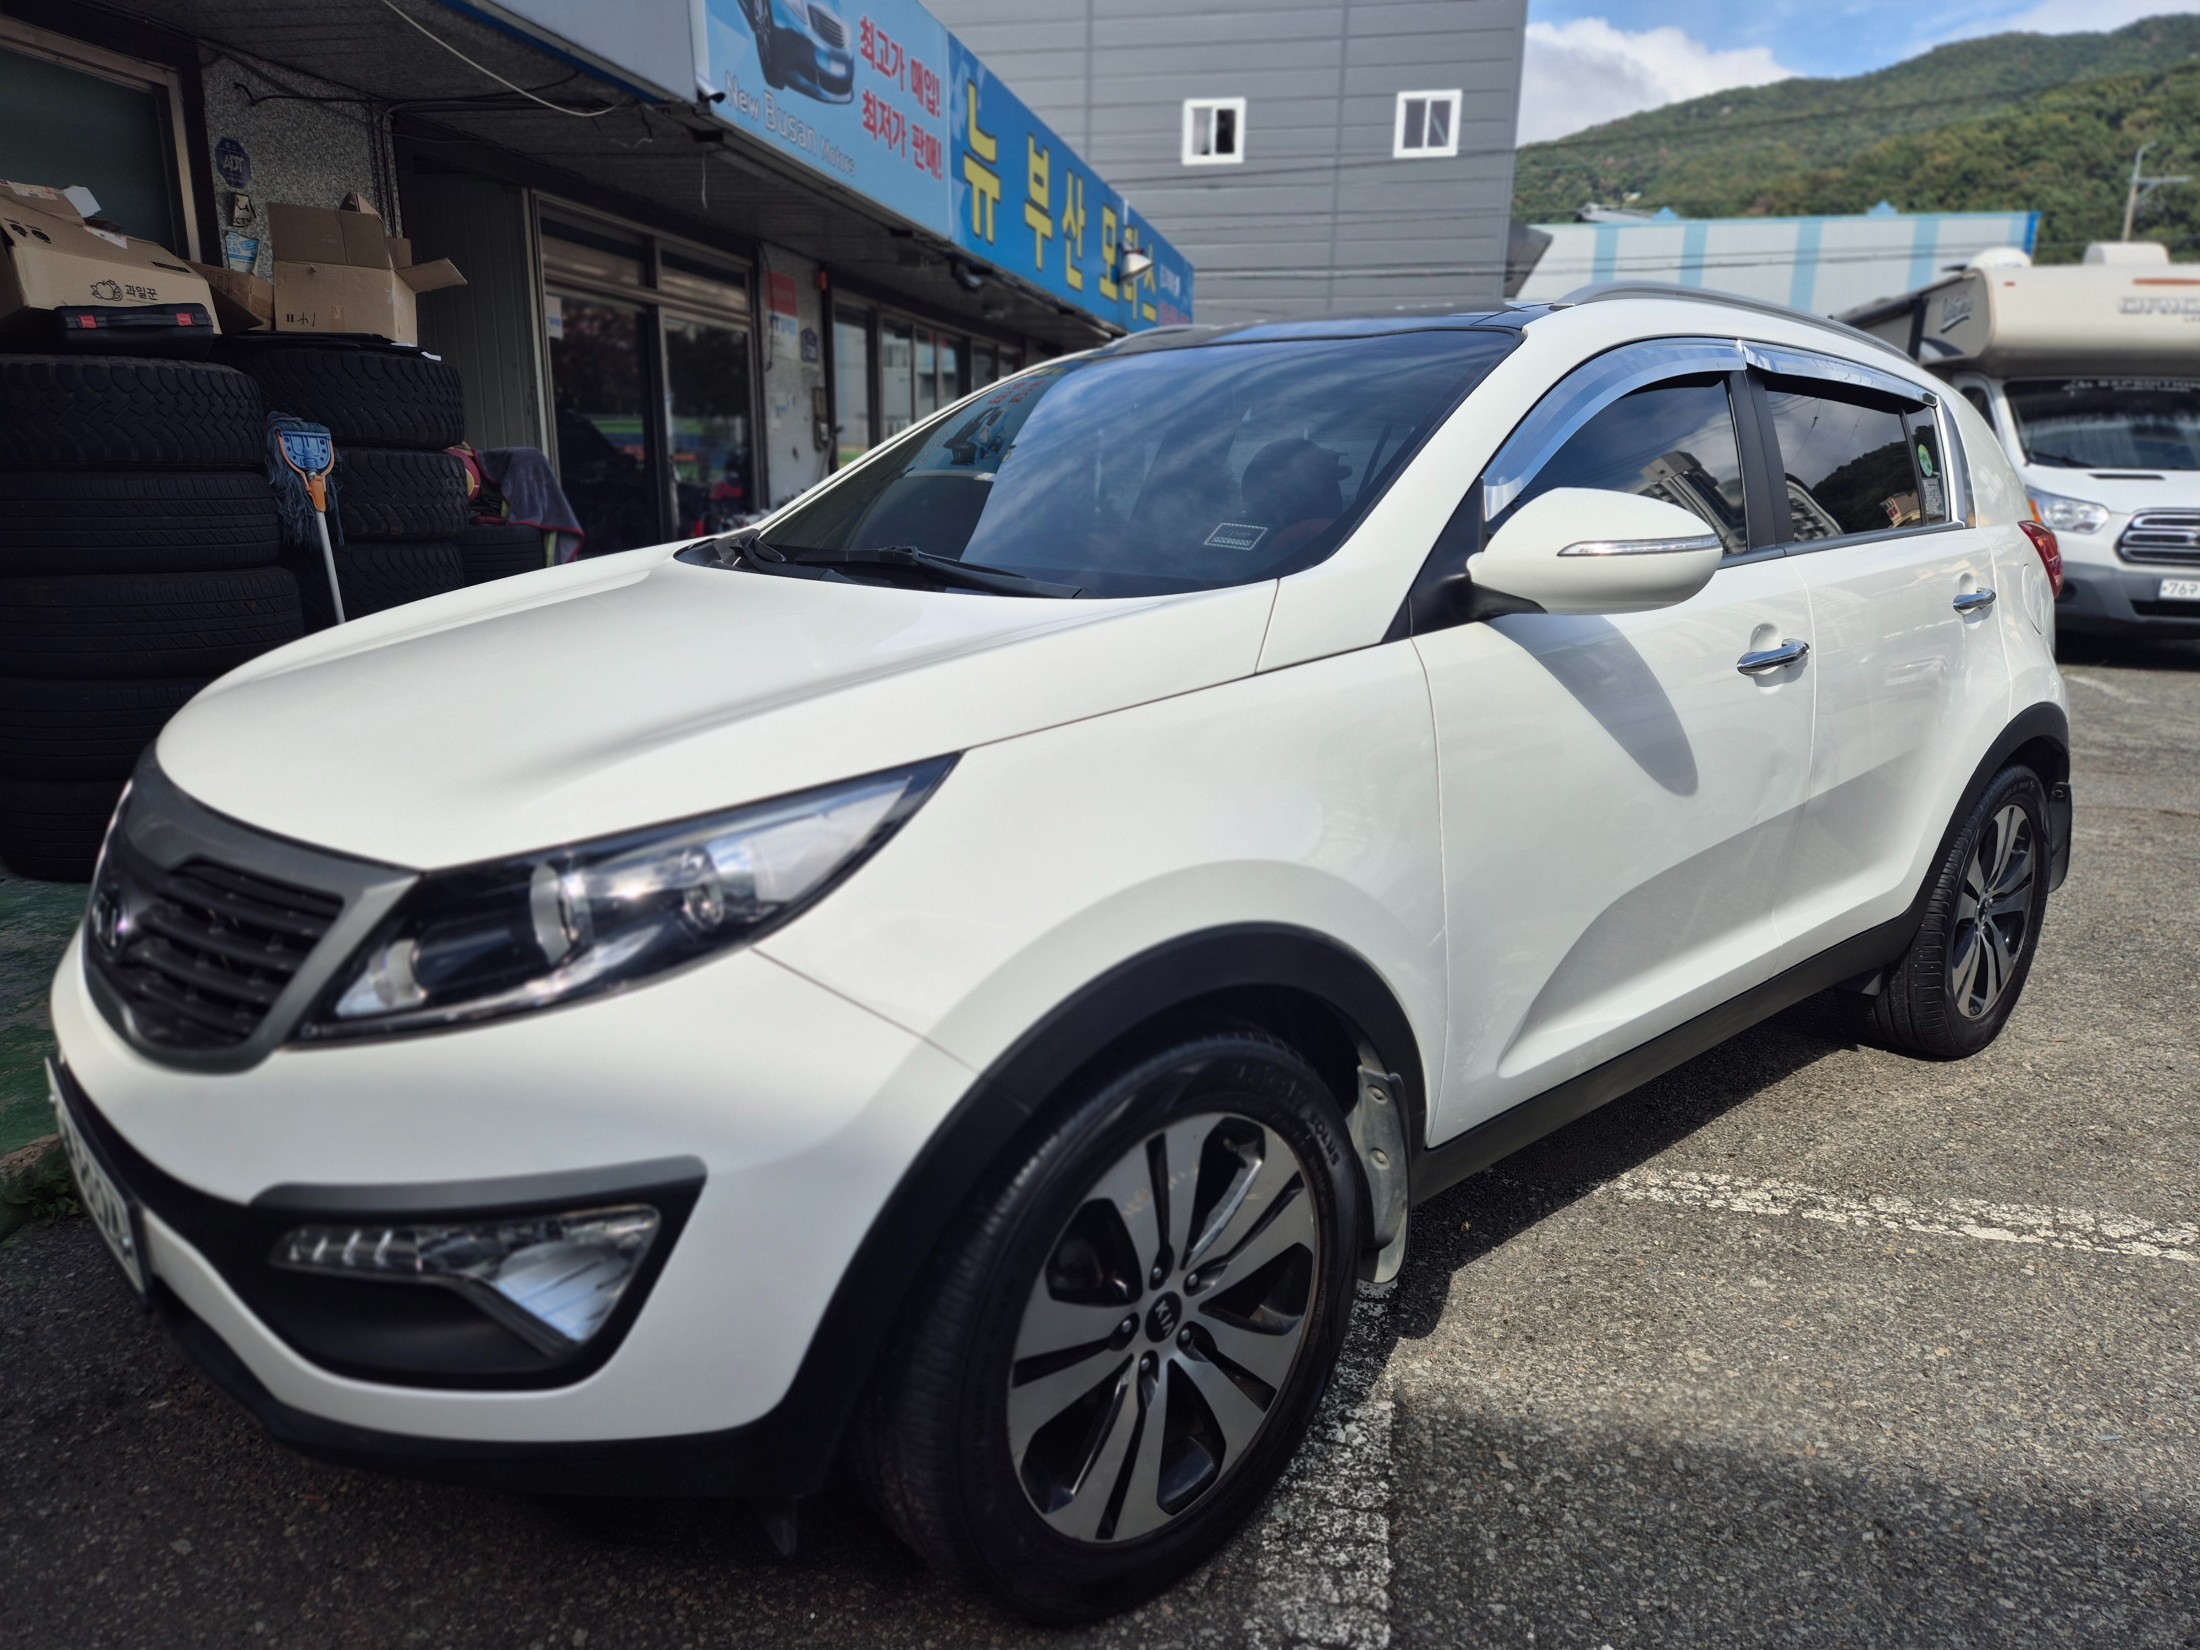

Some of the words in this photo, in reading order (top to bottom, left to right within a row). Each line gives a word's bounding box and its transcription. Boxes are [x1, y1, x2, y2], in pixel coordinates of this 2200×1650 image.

[860, 16, 905, 92] 최고가
[910, 58, 941, 118] 매입!
[725, 71, 759, 121] New
[764, 89, 817, 156] Busan
[862, 89, 907, 159] 최저가
[911, 123, 943, 181] 판매!
[223, 153, 244, 173] ADT
[963, 79, 1001, 246] 뉴
[124, 284, 158, 300] 과일꾼
[1308, 1112, 1341, 1167] SOLUS
[1154, 1298, 1175, 1337] KIA
